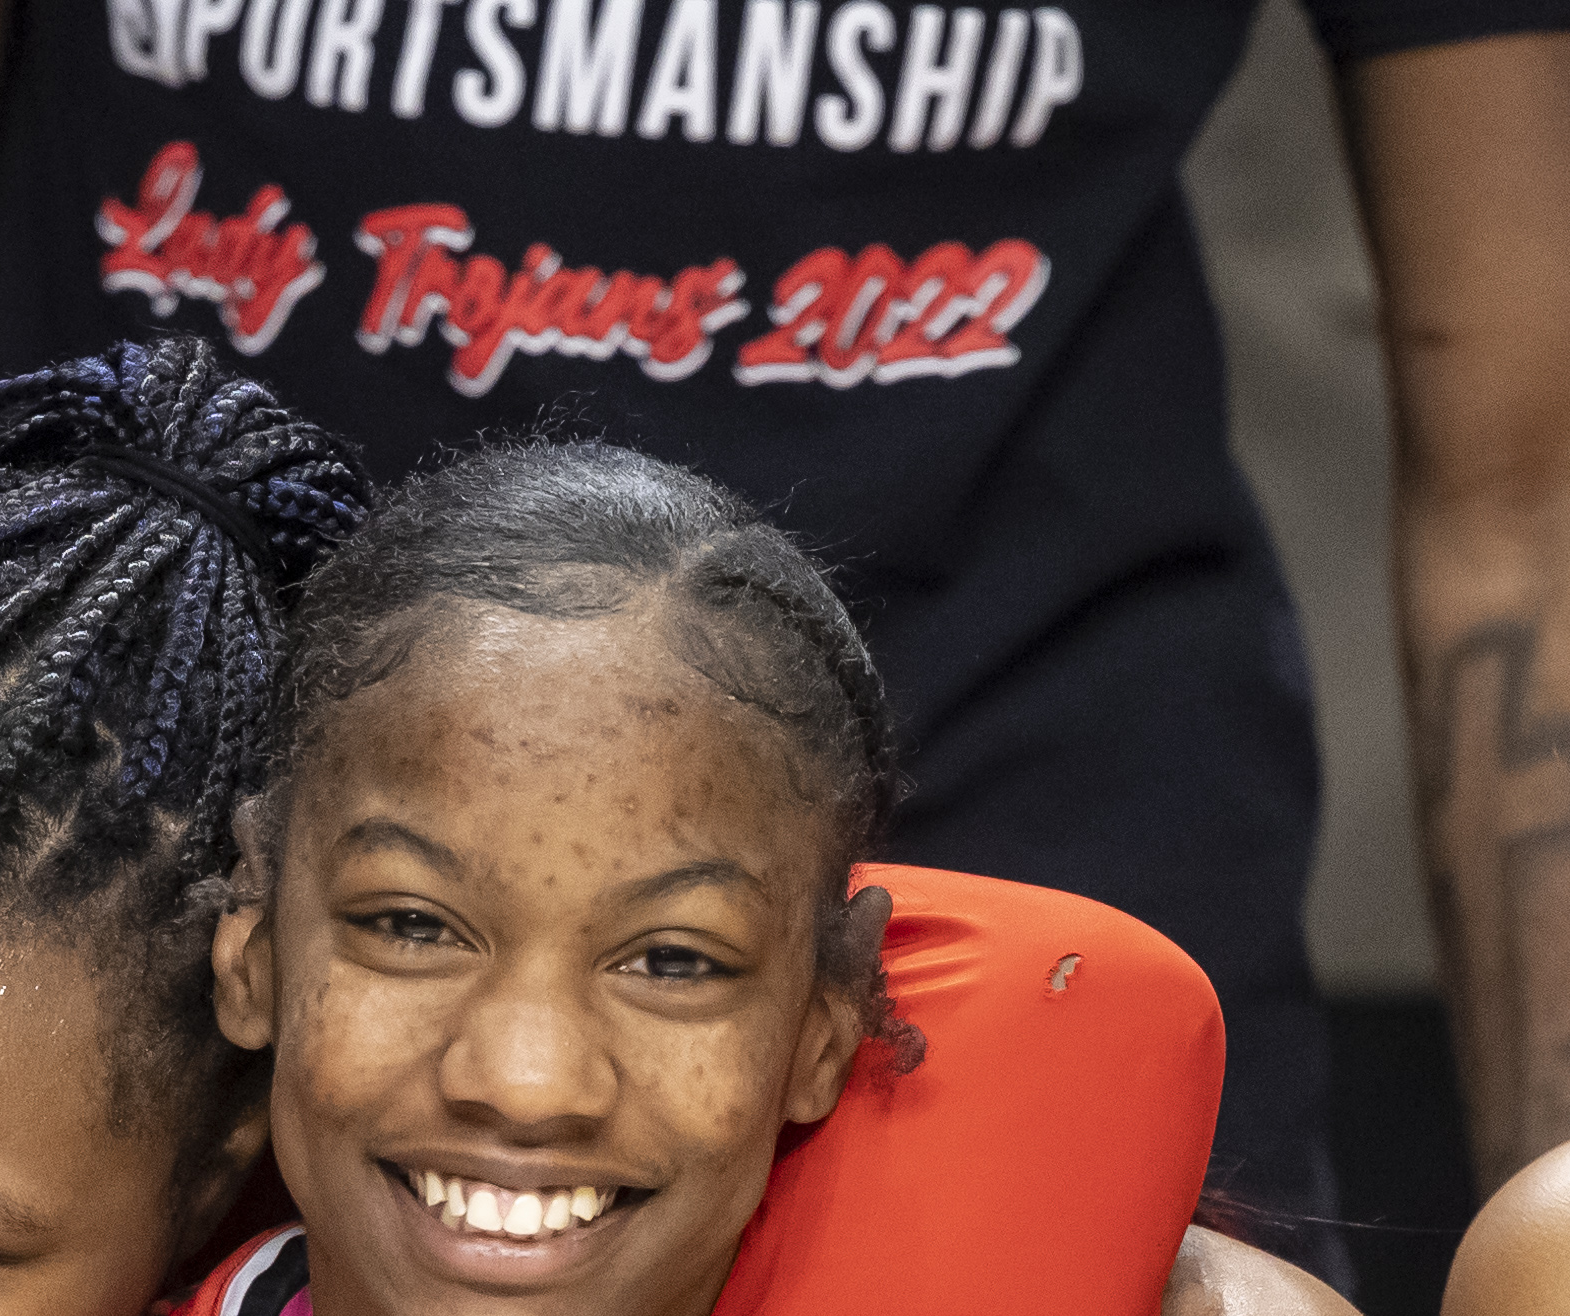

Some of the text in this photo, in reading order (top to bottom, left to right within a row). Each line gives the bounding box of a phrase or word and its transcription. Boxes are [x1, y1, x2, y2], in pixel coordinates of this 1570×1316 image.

[98, 139, 1054, 398] Lady Trojans 2022
